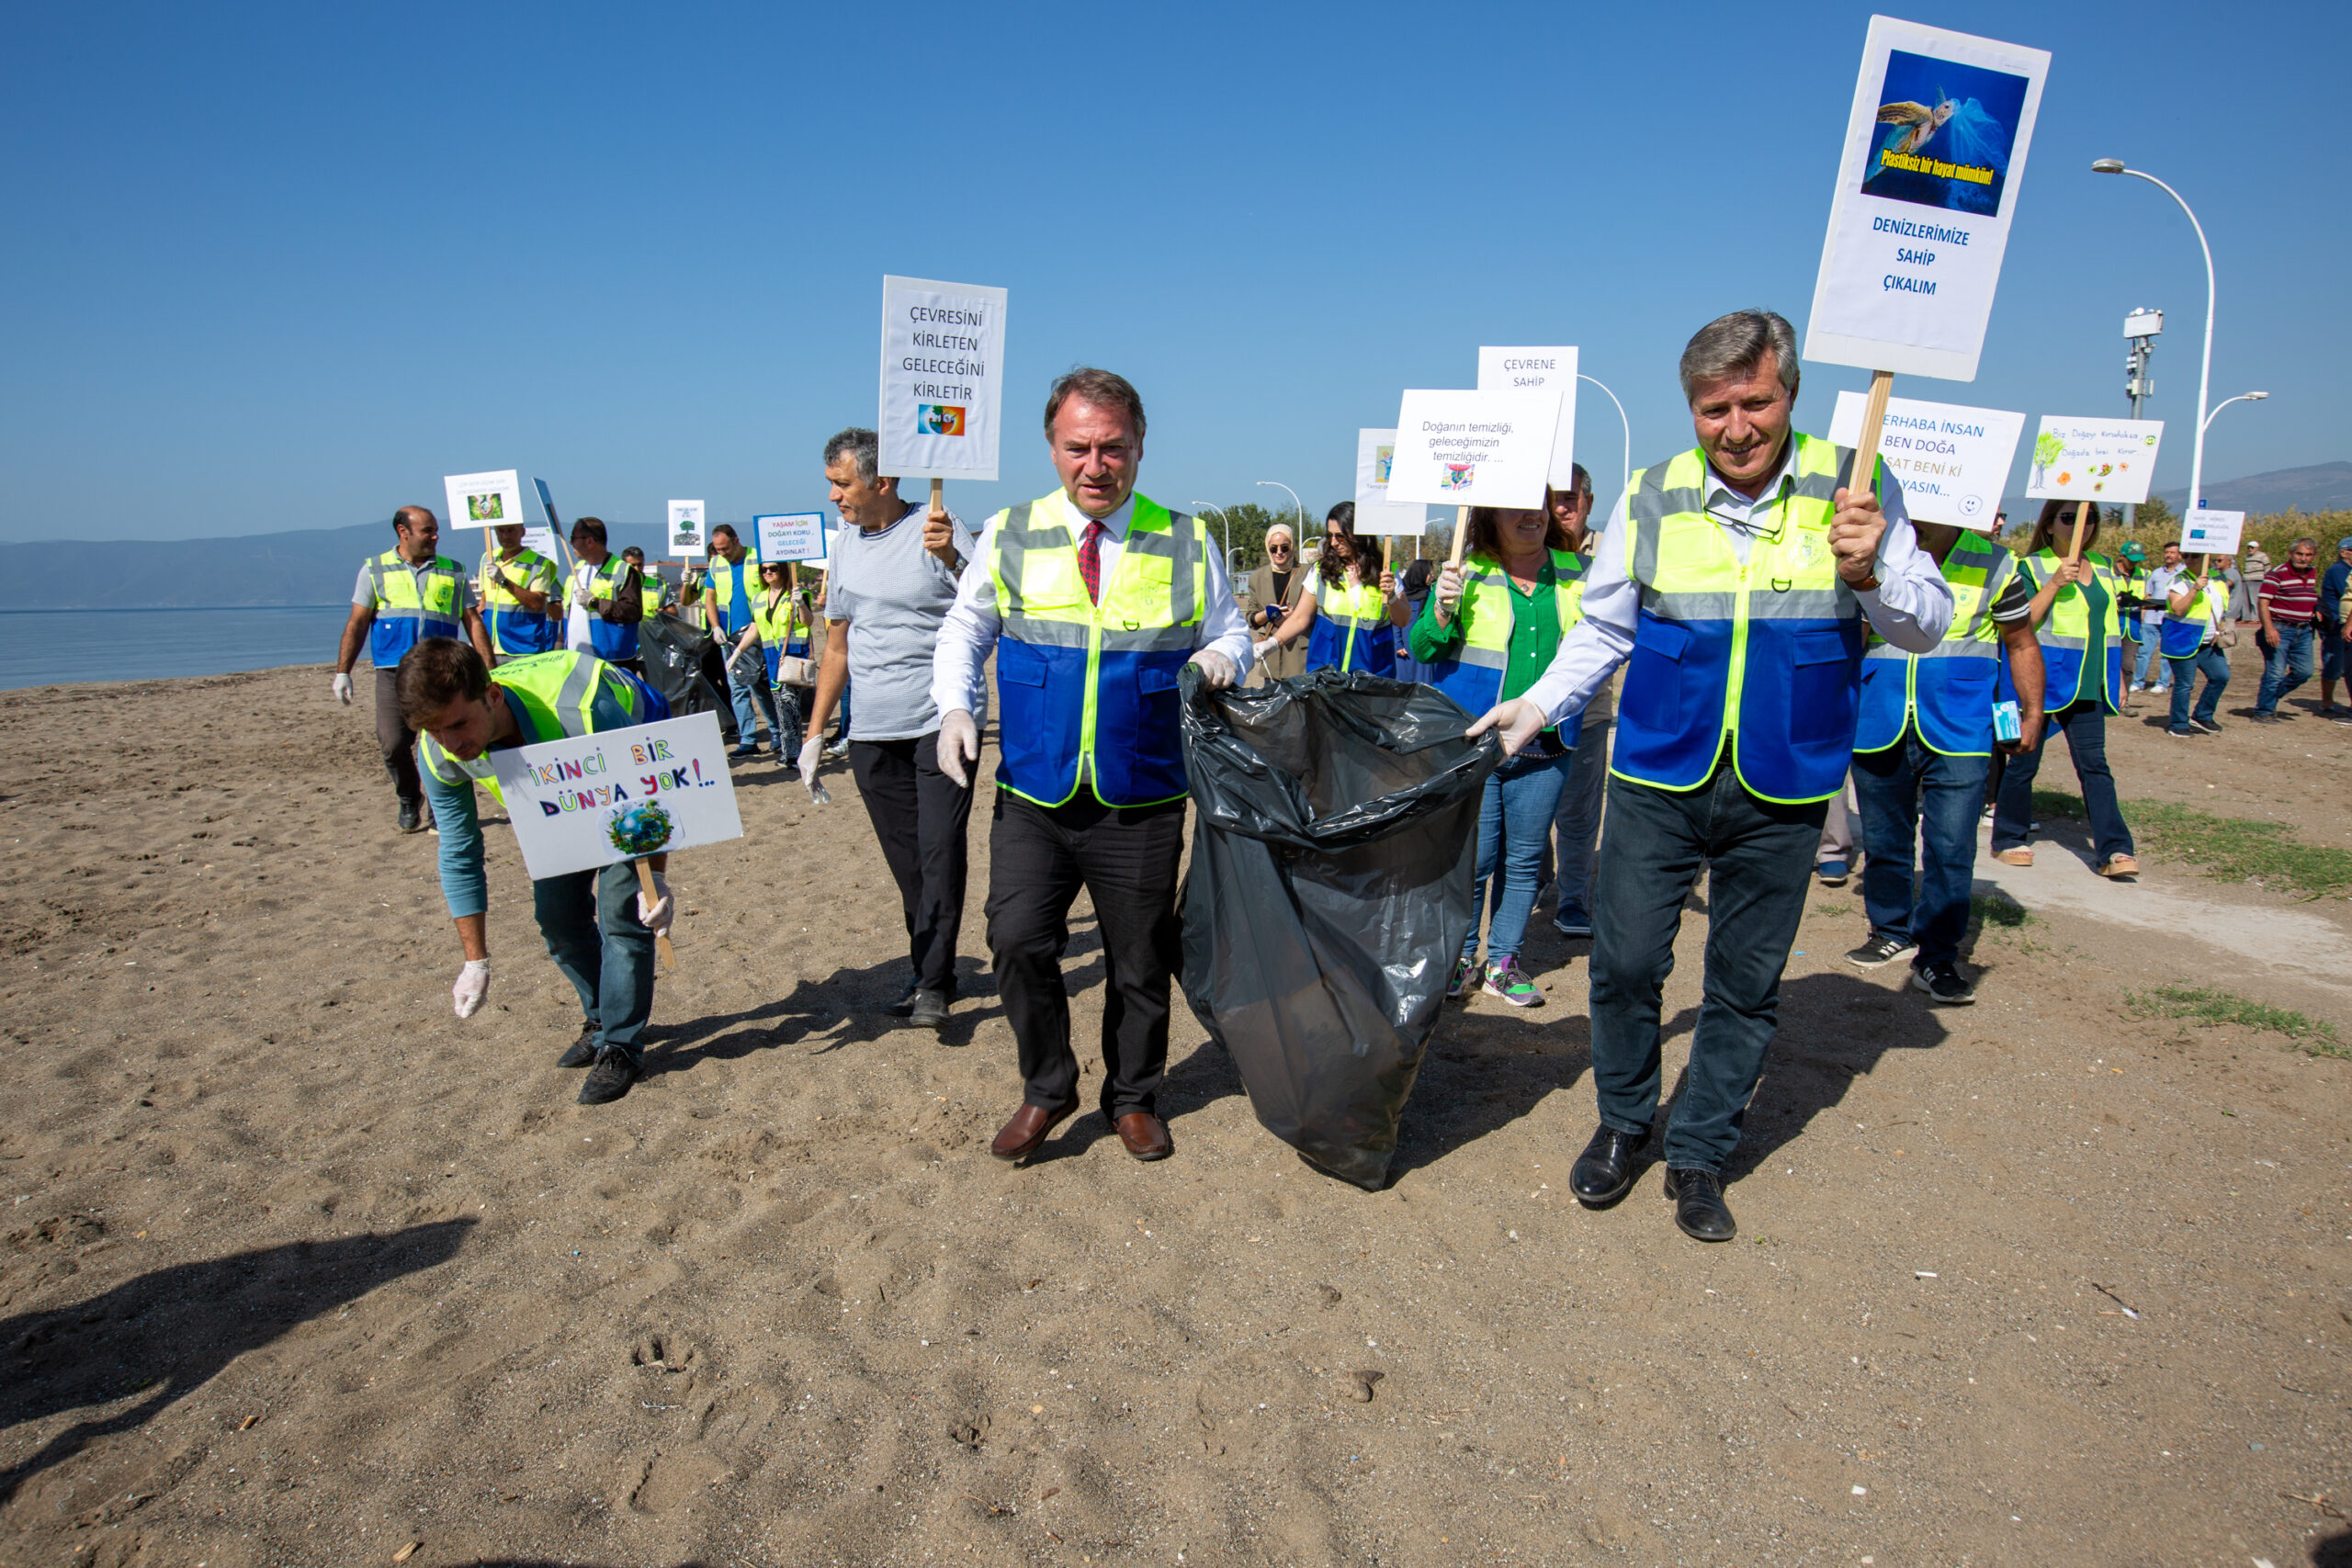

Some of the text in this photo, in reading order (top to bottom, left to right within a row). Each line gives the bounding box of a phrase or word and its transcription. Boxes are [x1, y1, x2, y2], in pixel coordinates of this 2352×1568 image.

[1881, 149, 1994, 186] Plastiksiz bir hayat mümkün!
[1872, 216, 1971, 246] DENİZLERİMİZE
[1896, 247, 1936, 266] SAHİP
[1883, 274, 1937, 295] ÇIKALIM
[910, 306, 983, 326] ÇEVRESİNİ
[912, 331, 978, 351] KİRLETEN
[902, 357, 985, 377] GELECEĞİNİ
[1504, 358, 1556, 372] ÇEVRENE
[913, 380, 972, 400] KİRLETİR
[1513, 375, 1545, 387] SAHİP
[1422, 421, 1514, 435] Doğanın temizliği,
[1883, 414, 1985, 438] ERHABA İNSAN
[1429, 436, 1500, 449] geleceğimizin
[1884, 434, 1956, 456] BEN DOĞA
[1913, 460, 1947, 475] BENİ
[1949, 464, 1963, 478] Kİ
[1902, 479, 1951, 497] YASIN...
[772, 521, 795, 529] YAŞAM
[526, 736, 674, 787] İKİNCİ BİR
[539, 782, 628, 818] DÜNYA
